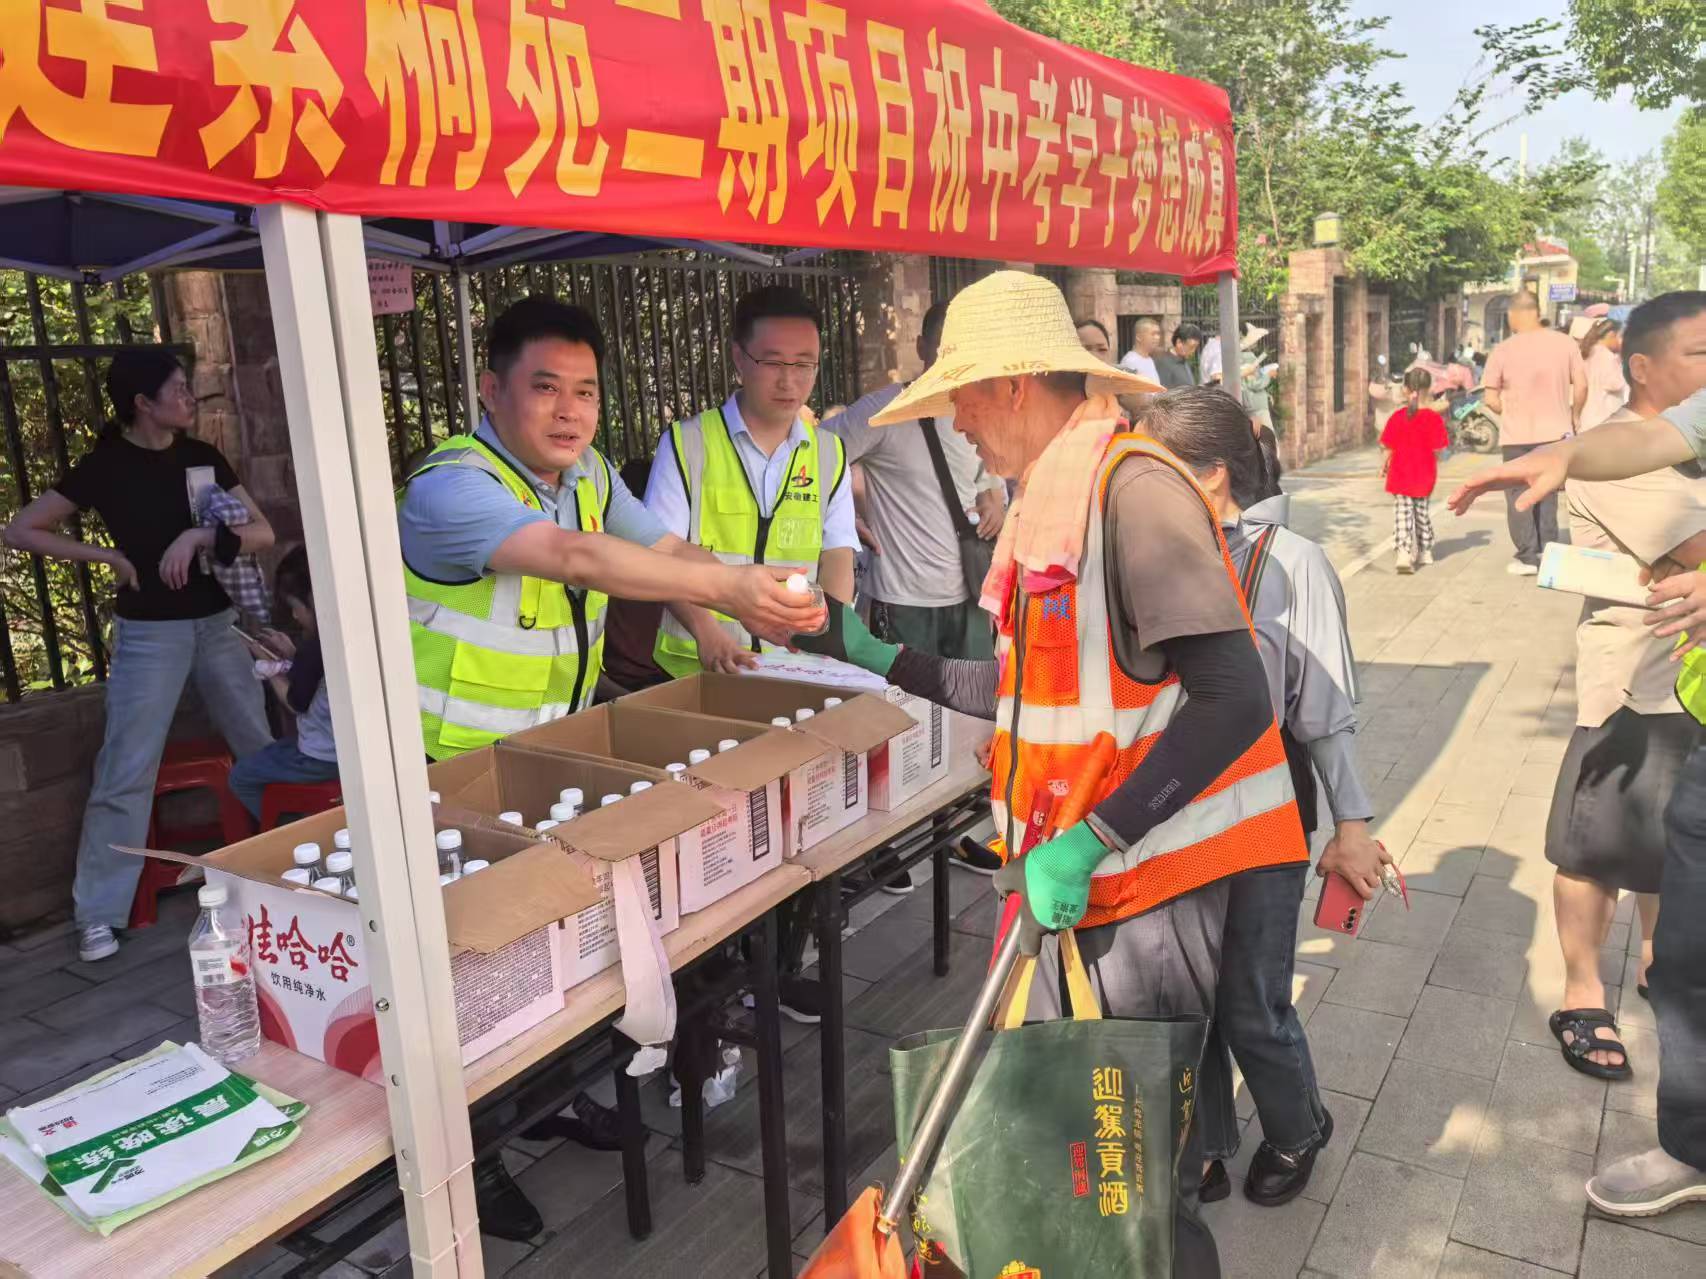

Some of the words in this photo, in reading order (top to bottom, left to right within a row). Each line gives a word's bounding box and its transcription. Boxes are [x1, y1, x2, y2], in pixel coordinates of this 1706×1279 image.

[270, 972, 327, 1001] 饮用纯净水
[72, 1093, 231, 1171] 晨读晚练
